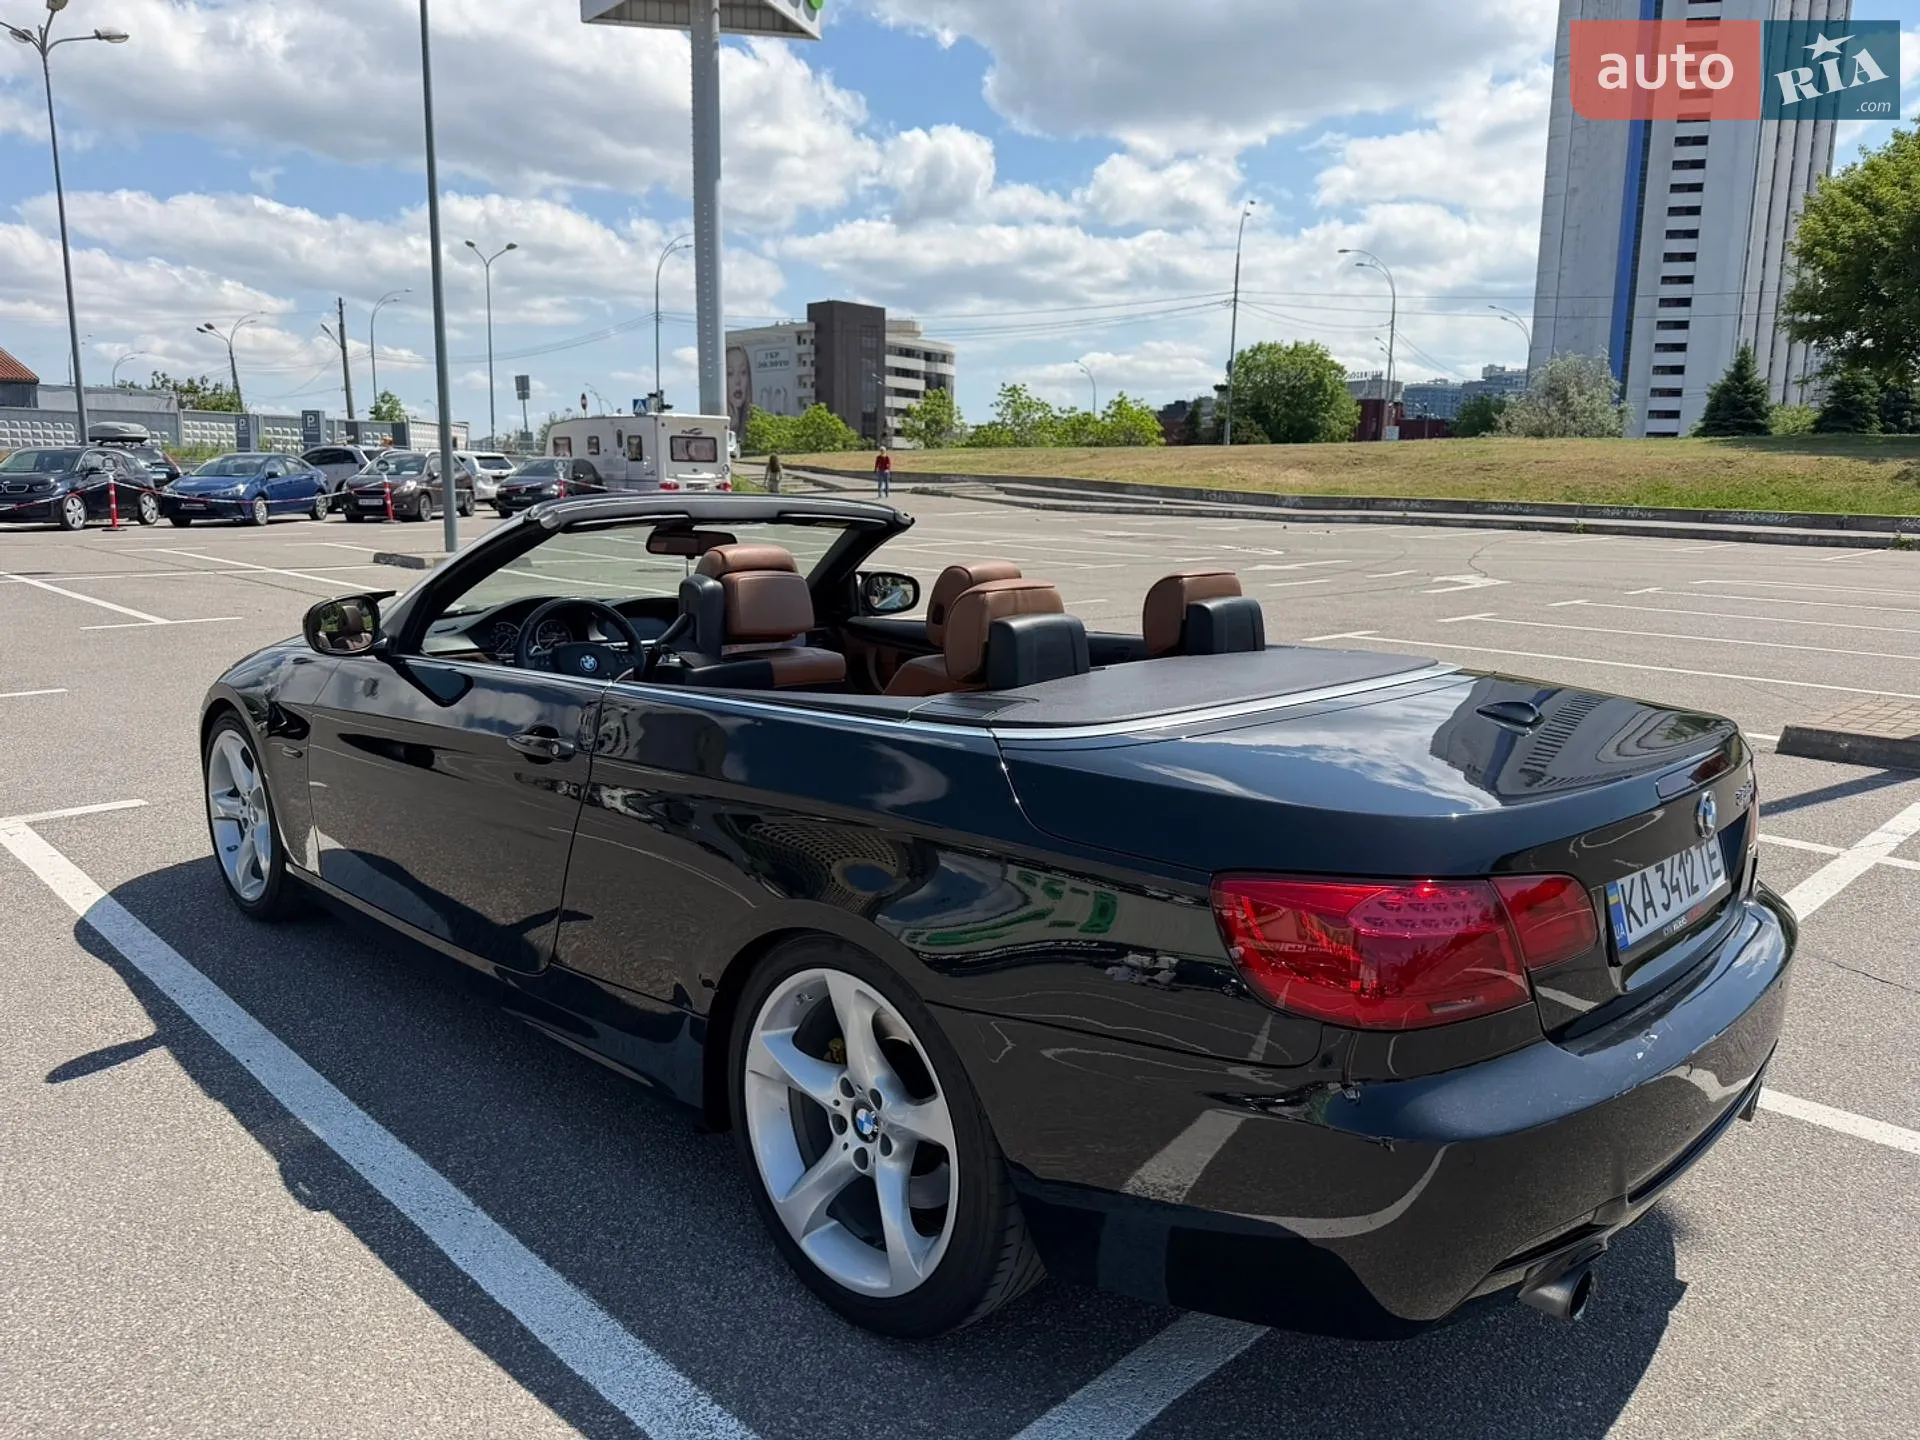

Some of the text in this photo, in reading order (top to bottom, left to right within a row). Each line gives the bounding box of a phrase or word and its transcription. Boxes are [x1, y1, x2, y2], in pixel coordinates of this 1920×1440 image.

[1620, 871, 1658, 934] KA
[1655, 848, 1700, 912] 3412
[1694, 836, 1721, 885] TE
[1613, 921, 1626, 940] UA
